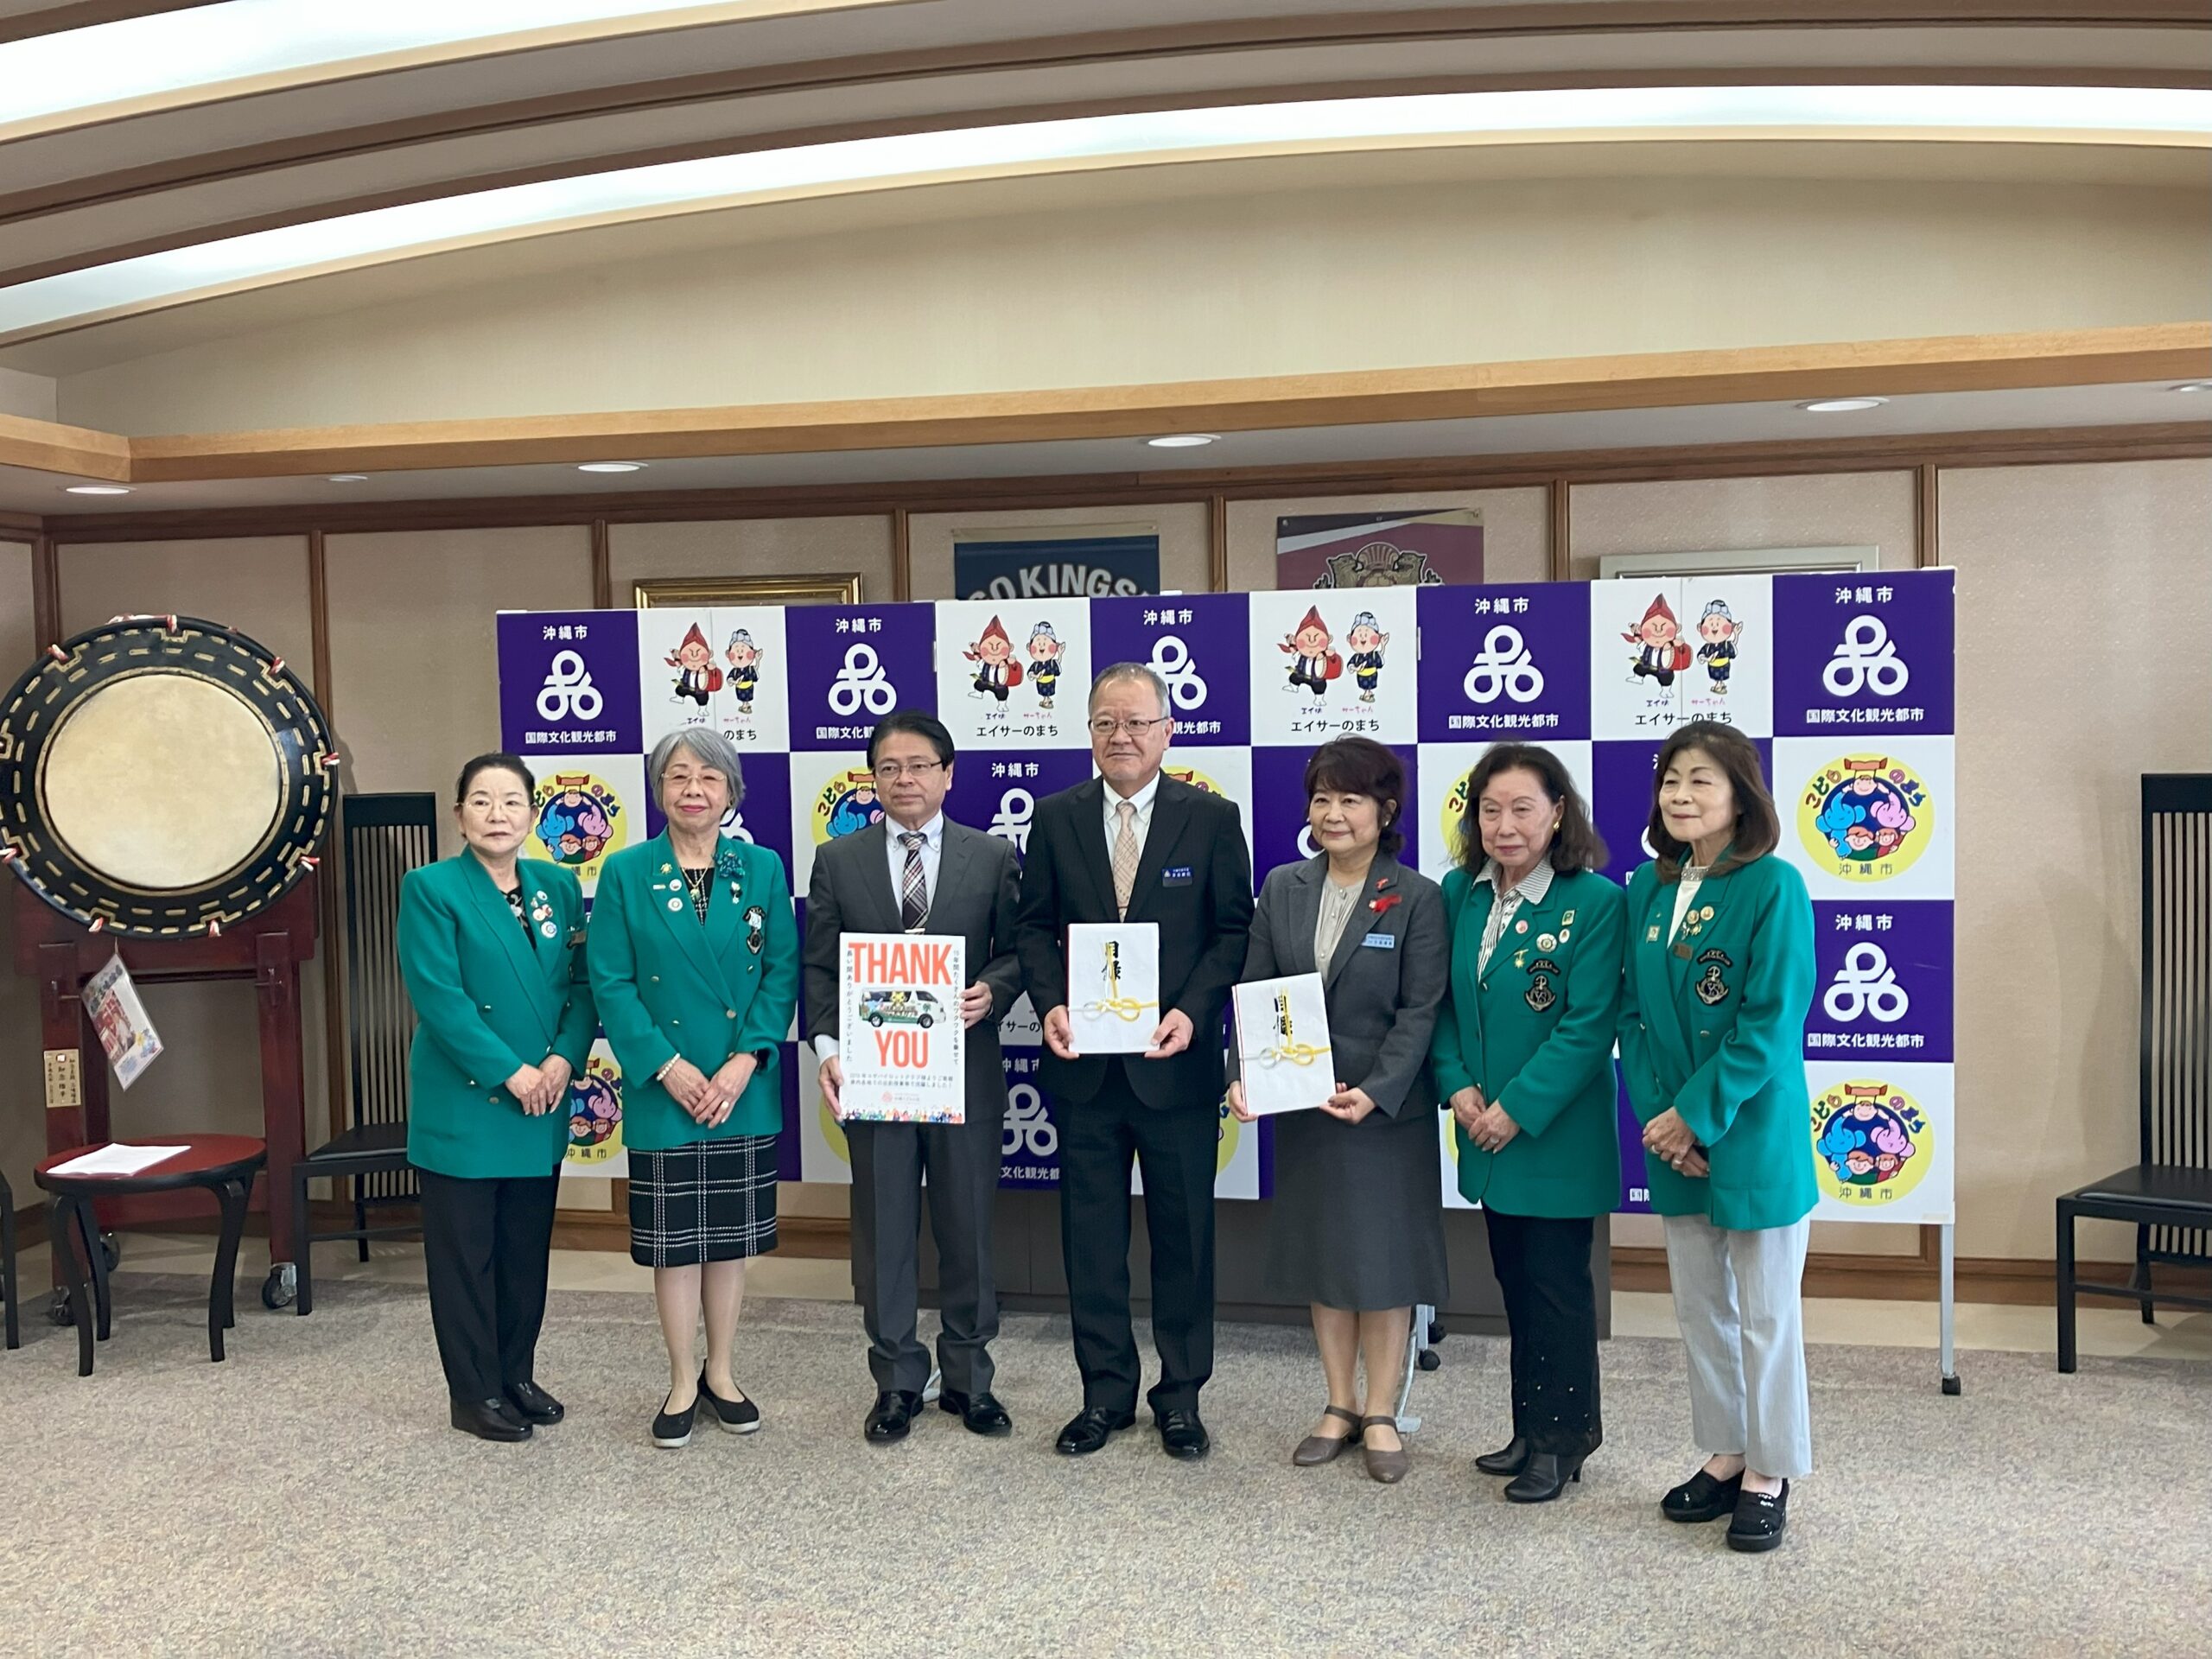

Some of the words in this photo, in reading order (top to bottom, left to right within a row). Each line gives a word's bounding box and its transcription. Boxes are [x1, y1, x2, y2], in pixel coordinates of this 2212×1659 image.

[1835, 586, 1893, 603] 沖縄市
[1475, 597, 1529, 614] 沖縄市
[1144, 609, 1192, 625] 沖縄市
[543, 625, 588, 640] 沖縄市
[836, 618, 881, 632] 沖縄市
[1449, 714, 1558, 728] 国際文化観光都市
[1635, 712, 1732, 726] エイサーのまち
[1807, 708, 1923, 723] 国際文化観光都市
[976, 725, 1058, 737] エイサーのまち
[1291, 719, 1380, 732] エイサーのまち
[525, 730, 616, 743] 国際文化観光都市
[992, 763, 1039, 778] 沖縄市
[1838, 861, 1893, 876] 沖縄市
[1835, 914, 1892, 931] 沖縄市
[849, 942, 952, 986] THANK
[1807, 1033, 1924, 1048] 国際文化観光都市
[874, 1030, 929, 1069] YOU
[1838, 1185, 1893, 1202] 沖縄市
